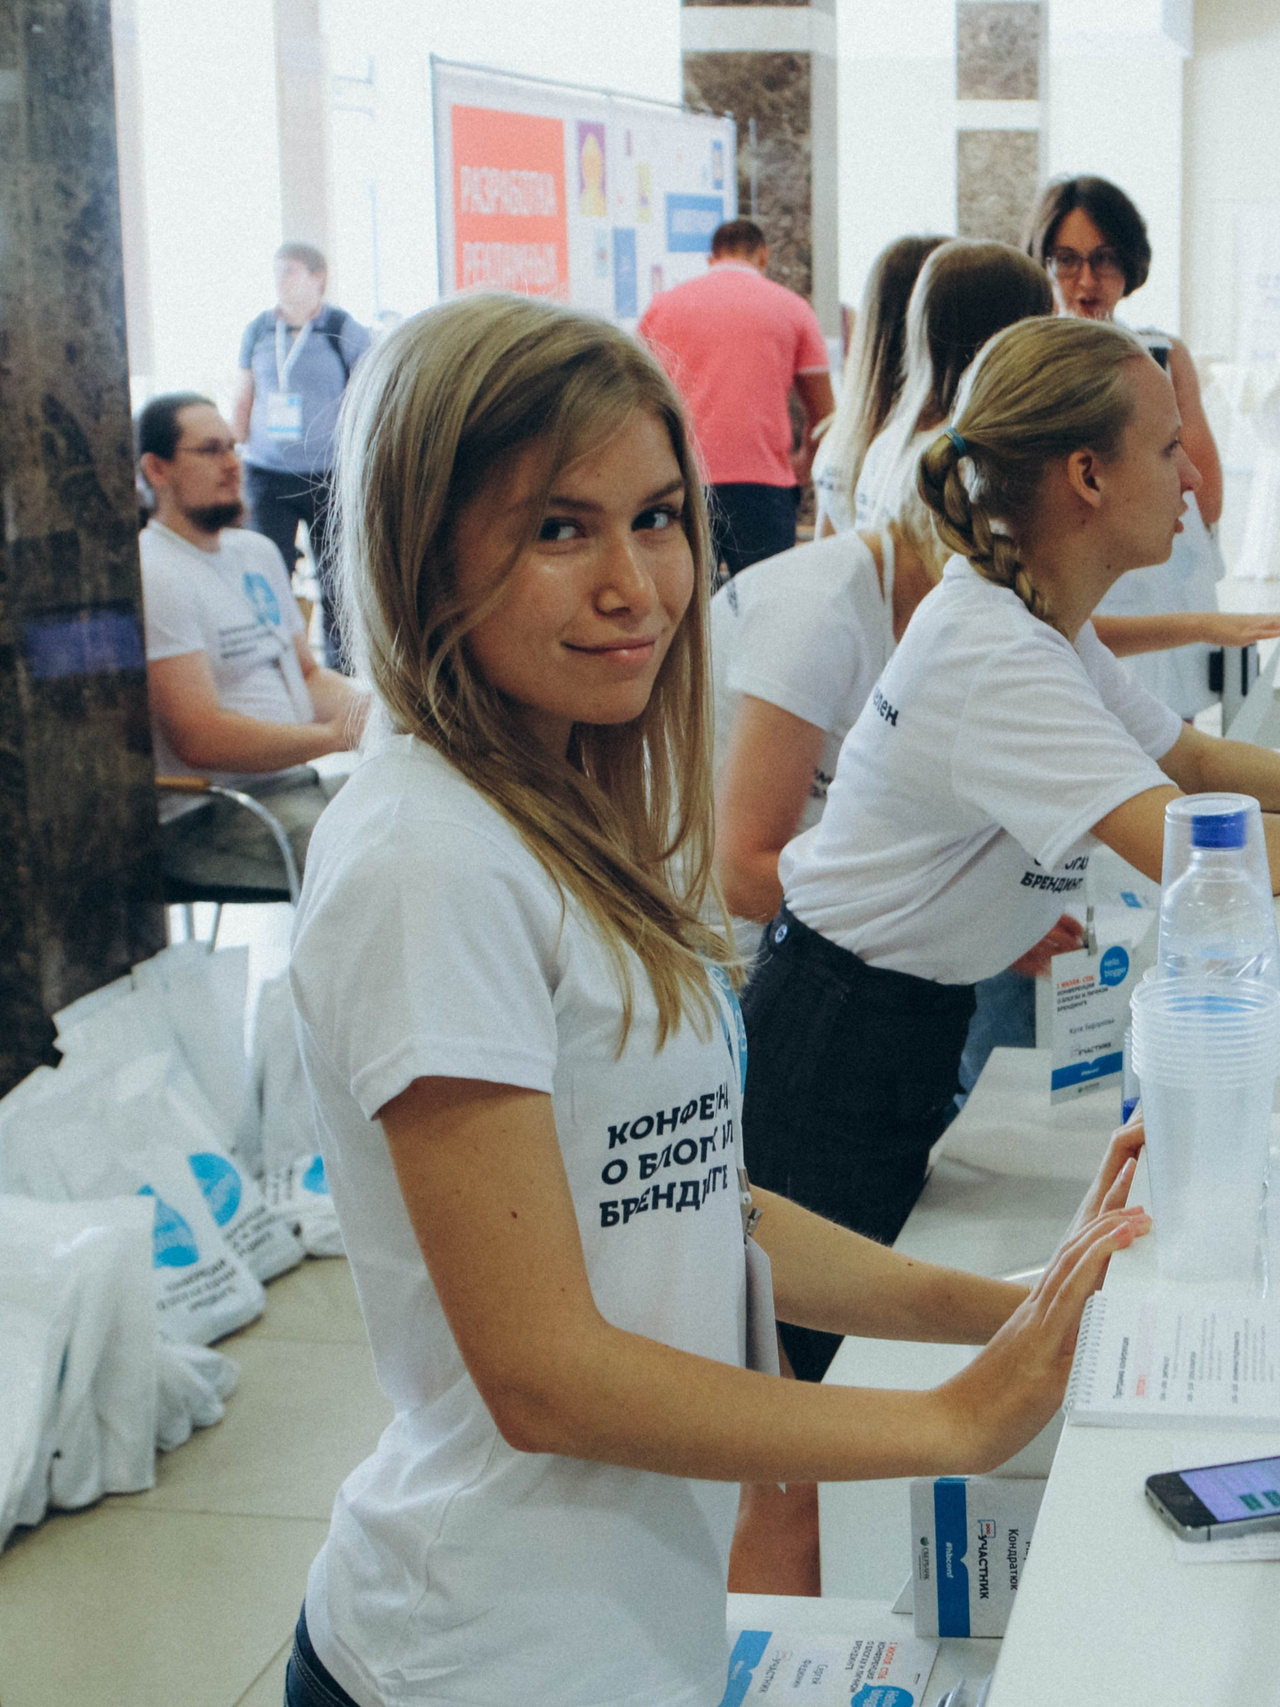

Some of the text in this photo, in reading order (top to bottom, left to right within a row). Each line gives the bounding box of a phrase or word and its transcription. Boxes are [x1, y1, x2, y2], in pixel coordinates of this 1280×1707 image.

[601, 1158, 628, 1185] О
[945, 1541, 955, 1579] #hbconf
[978, 1535, 990, 1600] УЧАСТНИК
[1006, 1528, 1019, 1591] Кондратюк
